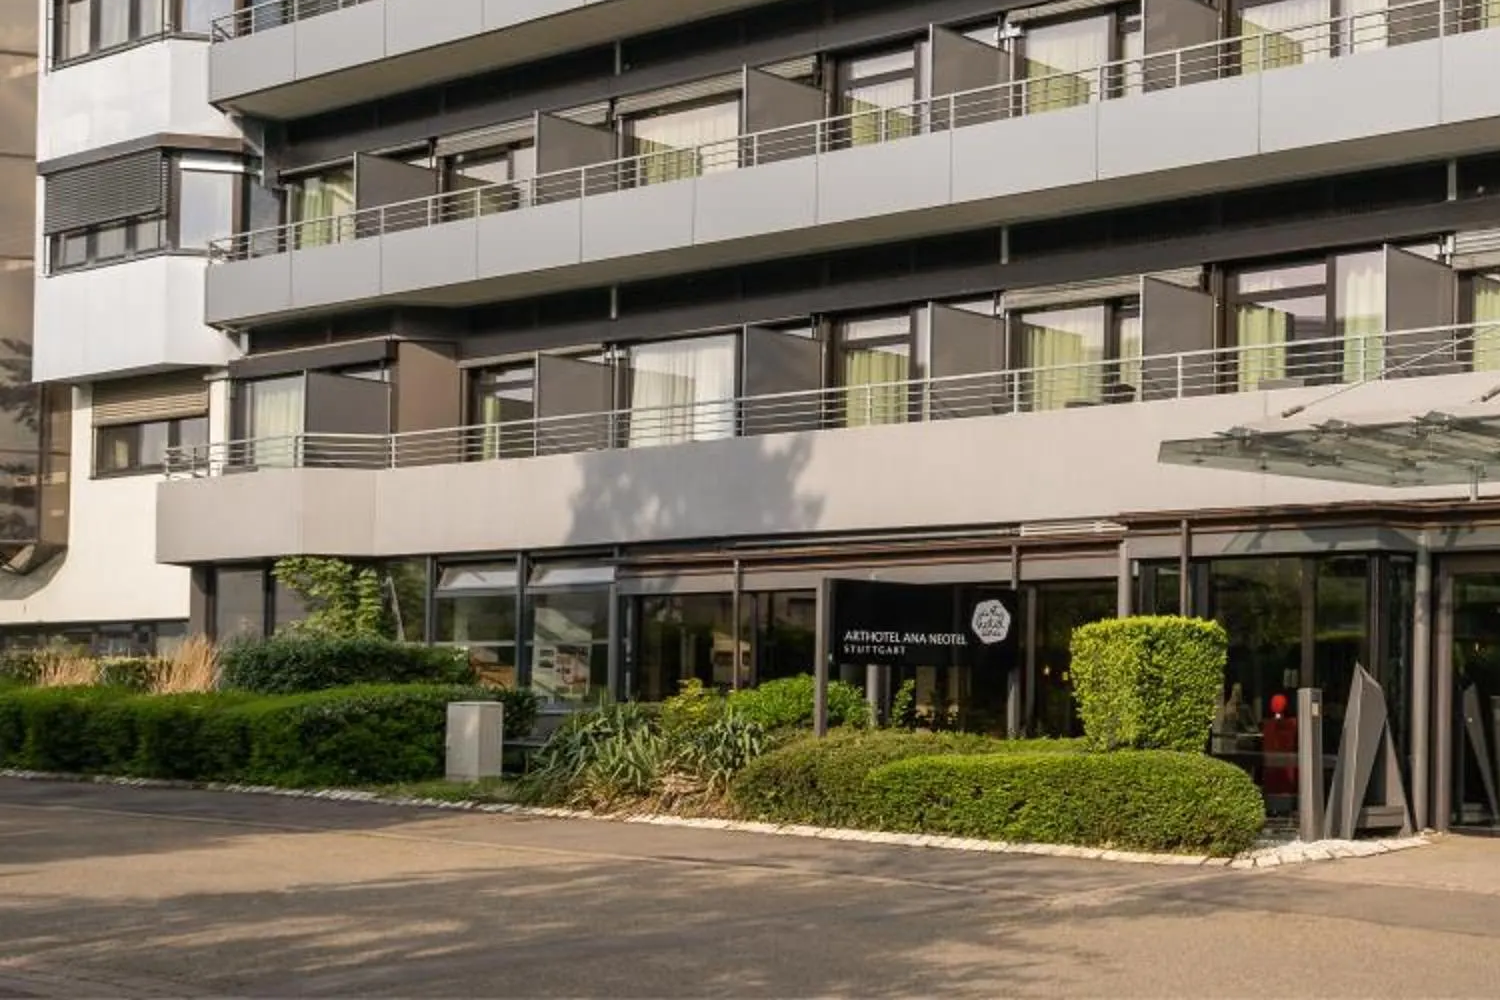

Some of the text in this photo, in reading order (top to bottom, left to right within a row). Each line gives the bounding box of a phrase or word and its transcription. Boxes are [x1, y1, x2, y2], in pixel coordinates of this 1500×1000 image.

[844, 631, 968, 646] ARTHOTEL ANA NEOTEL
[844, 645, 906, 656] STUTTGART
